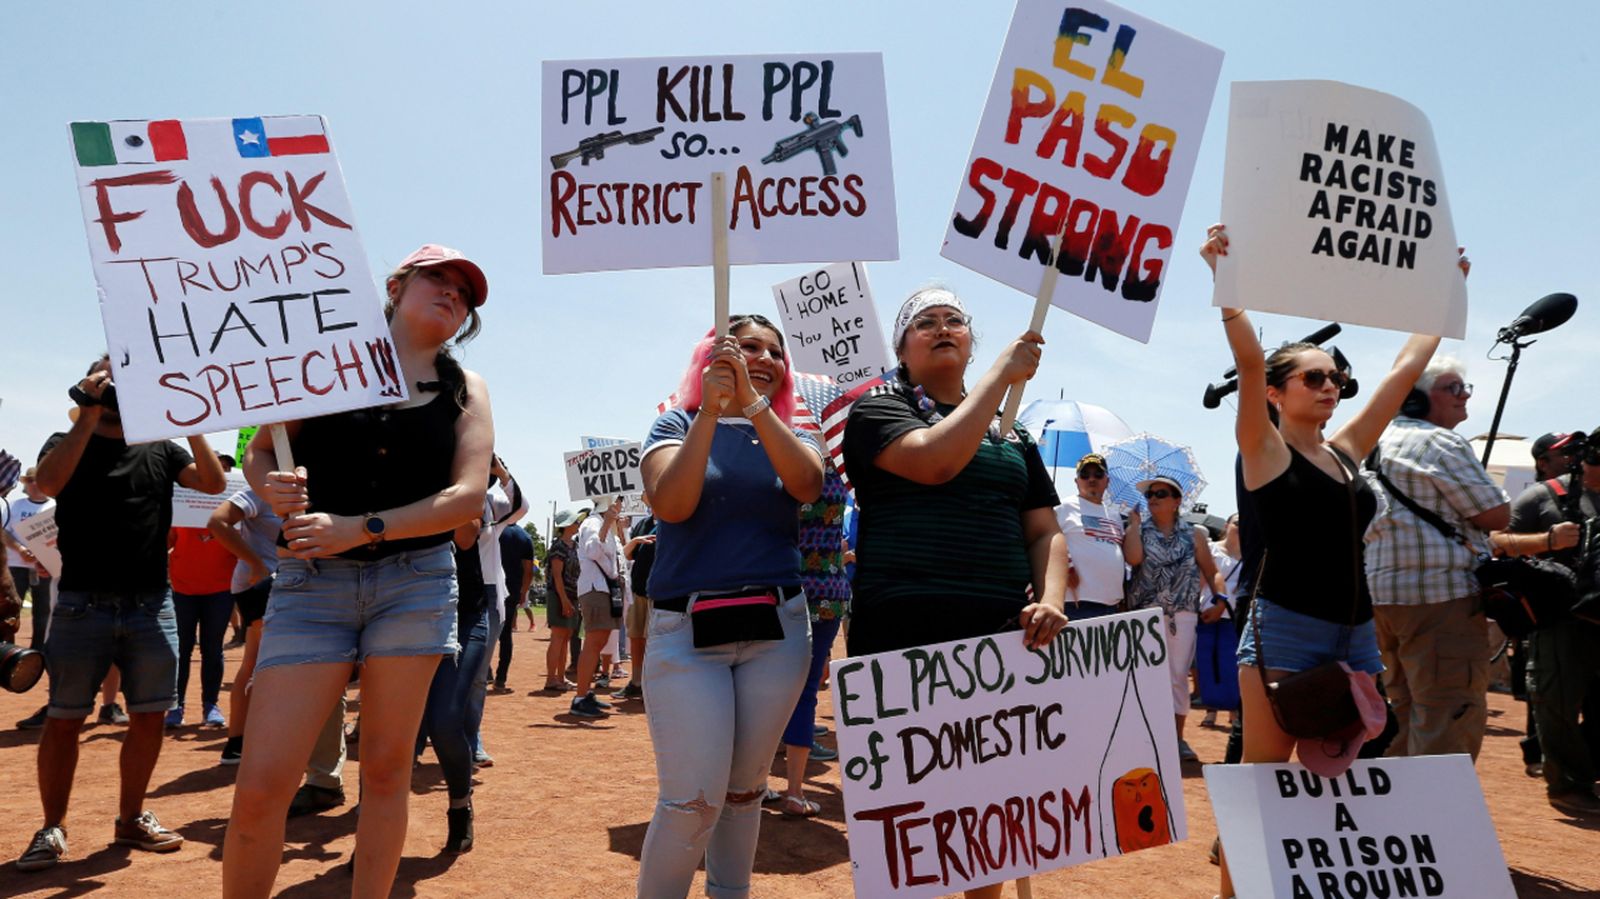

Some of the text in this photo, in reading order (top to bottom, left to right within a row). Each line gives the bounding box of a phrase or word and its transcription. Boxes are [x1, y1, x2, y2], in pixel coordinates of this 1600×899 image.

[1052, 7, 1144, 99] EL
[562, 60, 842, 125] PPL KILL PPL
[1004, 67, 1177, 197] PASO
[1324, 122, 1416, 169] MAKE
[550, 165, 867, 238] RESTRICT ACCESS
[1299, 152, 1437, 207] RACISTS
[88, 170, 354, 254] FUCK
[953, 157, 1173, 302] STRONG
[1307, 189, 1432, 239] AFRAID
[1312, 226, 1417, 270] AGAIN
[103, 242, 345, 304] TRUMP'S
[799, 270, 830, 296] GO
[147, 289, 358, 363] HATE
[797, 286, 848, 319] HOME
[831, 316, 863, 337] Are
[822, 335, 860, 363] NOT
[829, 366, 872, 384] COME
[577, 448, 640, 475] WORDS
[583, 472, 635, 496] KILL
[838, 615, 1166, 726] EL PASO, SURVIVORS
[845, 703, 1066, 790] of DOMESTIC
[1275, 767, 1391, 798] BUILD
[853, 784, 1092, 889] TERRORISM
[1335, 803, 1358, 832] A
[1282, 835, 1437, 869] PRISON
[1292, 866, 1444, 899] AROUND
